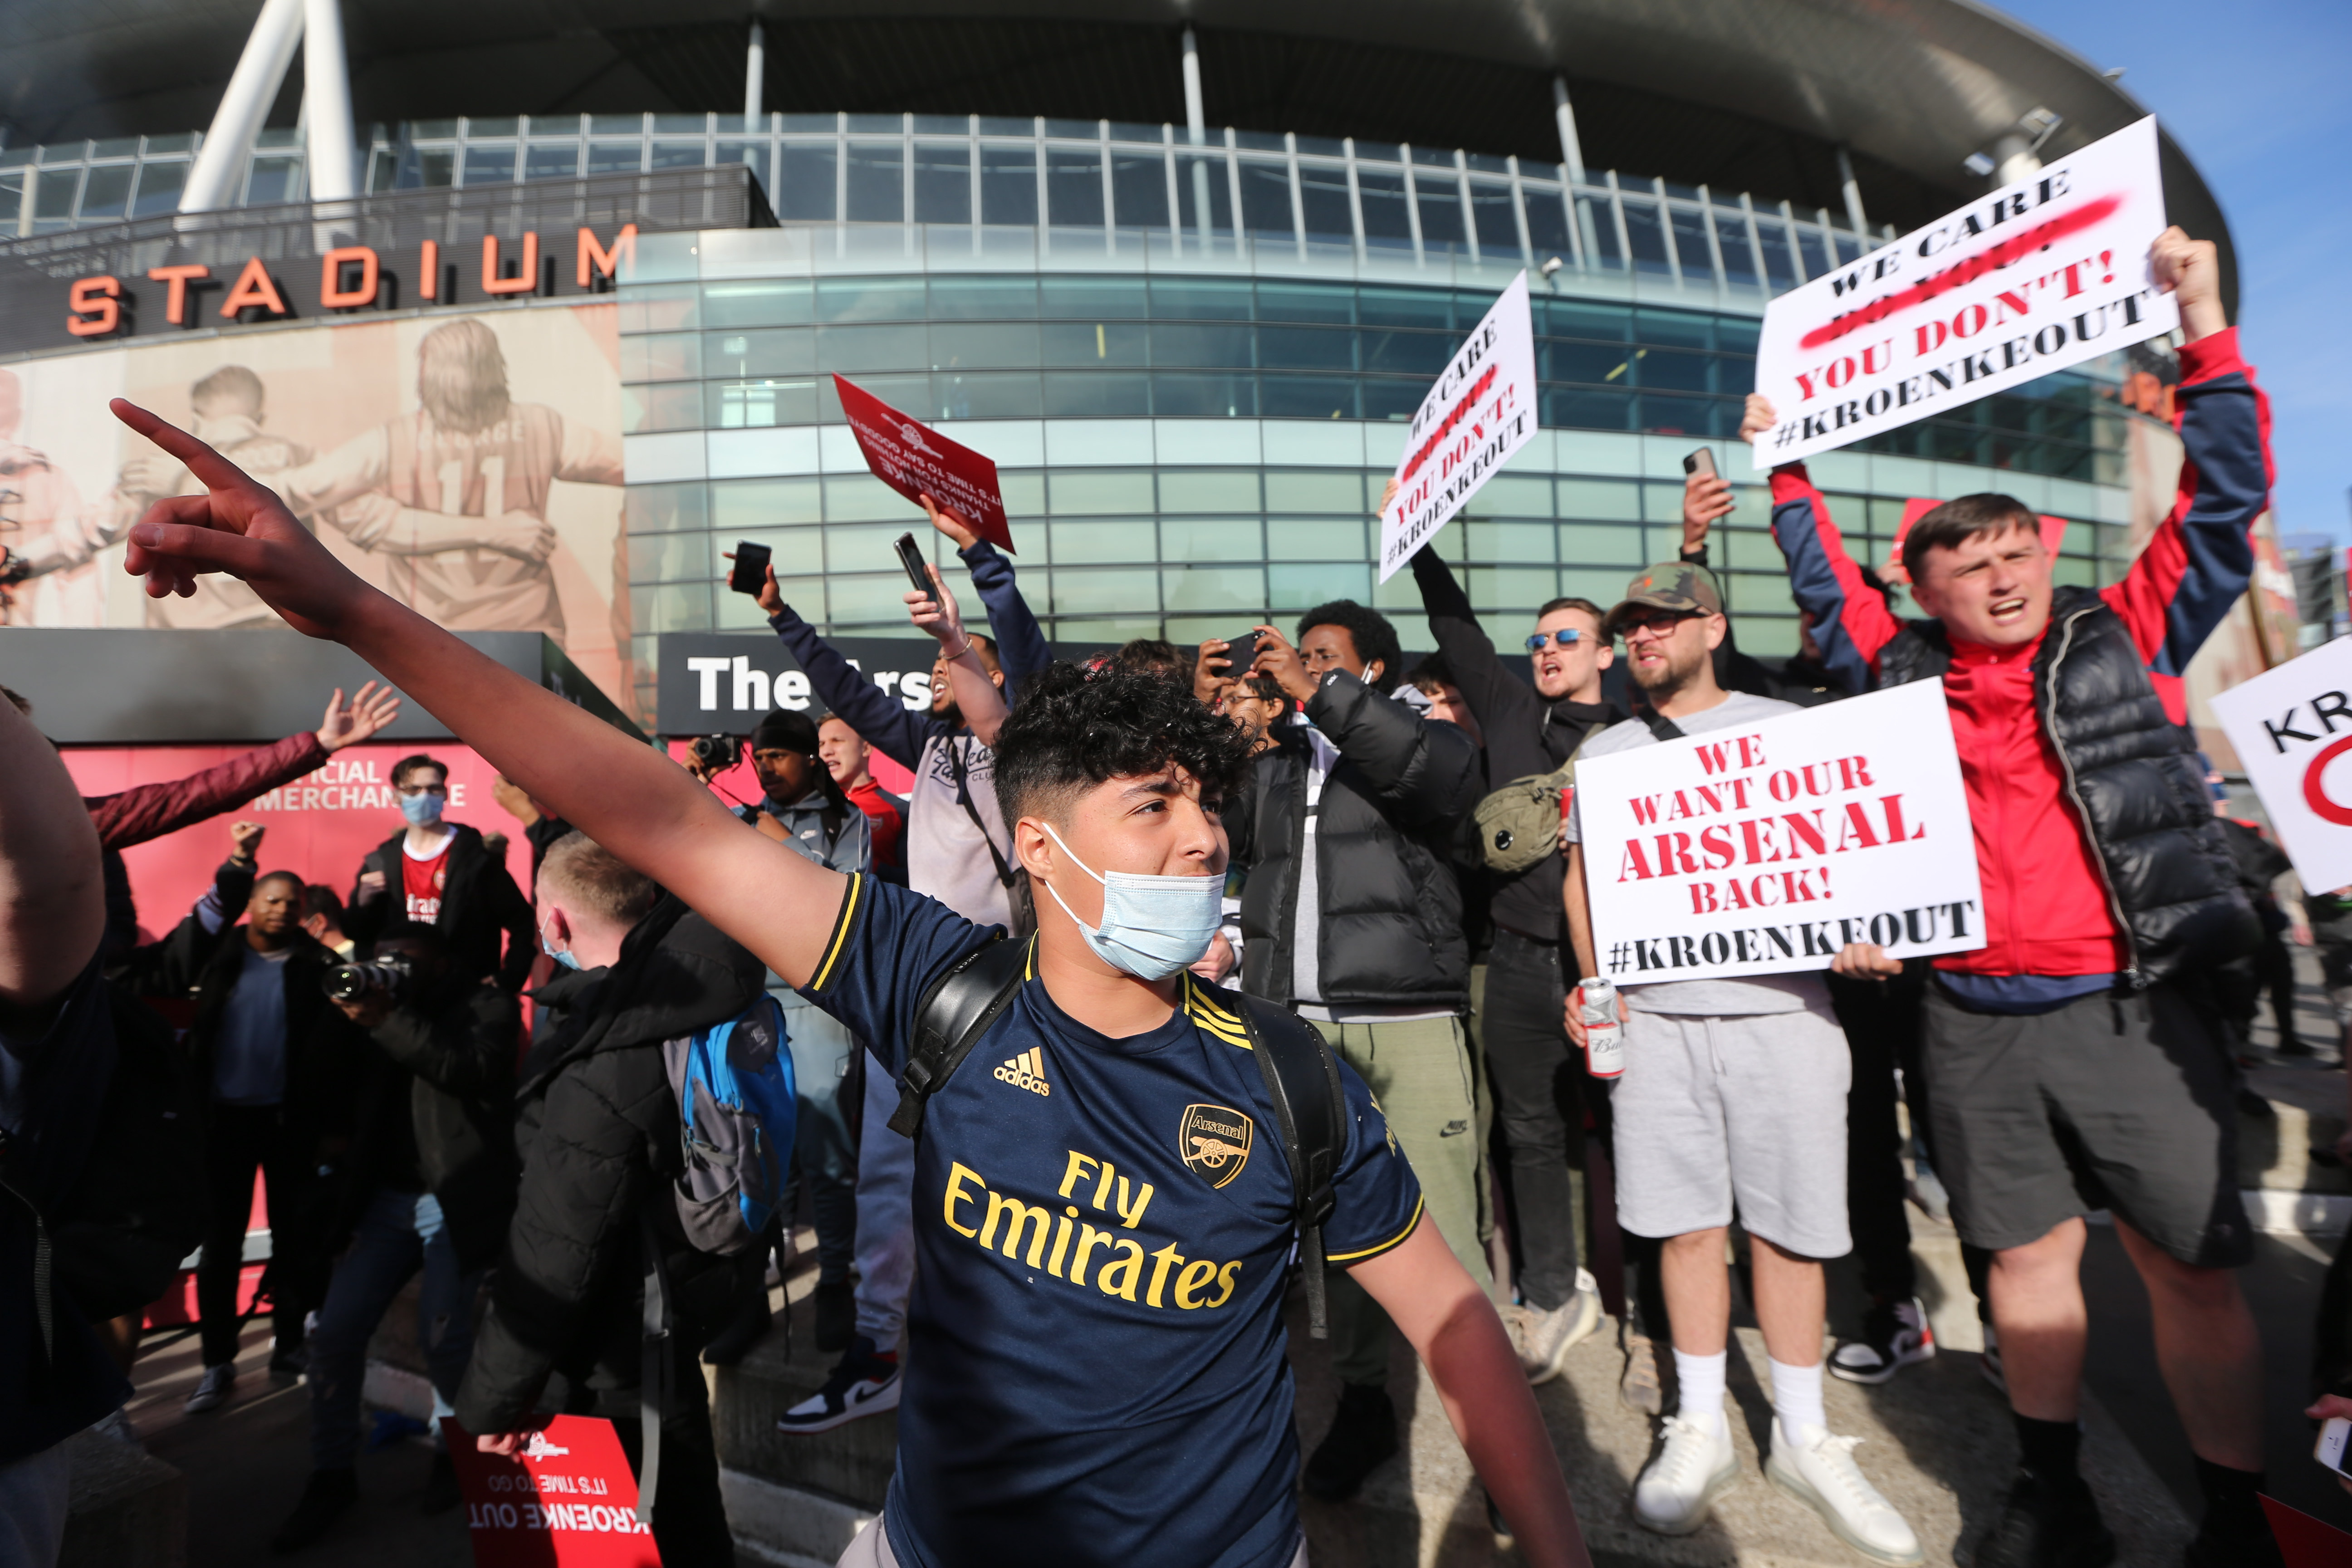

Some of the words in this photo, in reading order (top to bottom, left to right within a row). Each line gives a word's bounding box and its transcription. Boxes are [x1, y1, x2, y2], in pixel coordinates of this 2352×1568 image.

[1832, 249, 1901, 297] WE
[1917, 168, 2070, 258] CARE
[67, 223, 638, 336] STADIUM
[1795, 338, 1891, 402] YOU
[1916, 250, 2114, 358] DON'T!
[1412, 395, 1436, 440] WE
[1441, 319, 1497, 401] CARE
[1773, 287, 2149, 449] #KROENKEOUT
[863, 435, 911, 470] NOTHING
[903, 449, 926, 467] SAY
[913, 465, 938, 484] FOR
[927, 462, 945, 476] TO
[1397, 484, 1436, 525] YOU
[1442, 383, 1515, 481] DON'T!
[436, 455, 505, 517] 11
[879, 456, 983, 523] KROENKE
[940, 480, 990, 511] THANKS
[946, 471, 976, 494] TIME
[1386, 410, 1527, 567] #KROENKEOUT
[687, 655, 811, 711] The
[1695, 734, 1767, 775] WE
[1629, 777, 1754, 826] WANT
[1768, 755, 1877, 802] OUR
[1617, 793, 1926, 882] ARSENAL
[1688, 867, 1834, 915] BACK!
[1607, 900, 1975, 975] #KROENKEOUT
[994, 1067, 1049, 1097] adidas
[1191, 1115, 1244, 1140] Arsenal
[1058, 1149, 1154, 1229] Fly
[944, 1161, 1242, 1309] Emirates
[488, 1475, 512, 1492] GO
[516, 1475, 539, 1492] TO
[539, 1474, 578, 1494] TIME
[580, 1476, 608, 1495] IT'S
[469, 1503, 518, 1529] OUT
[523, 1503, 650, 1535] KROENKE
